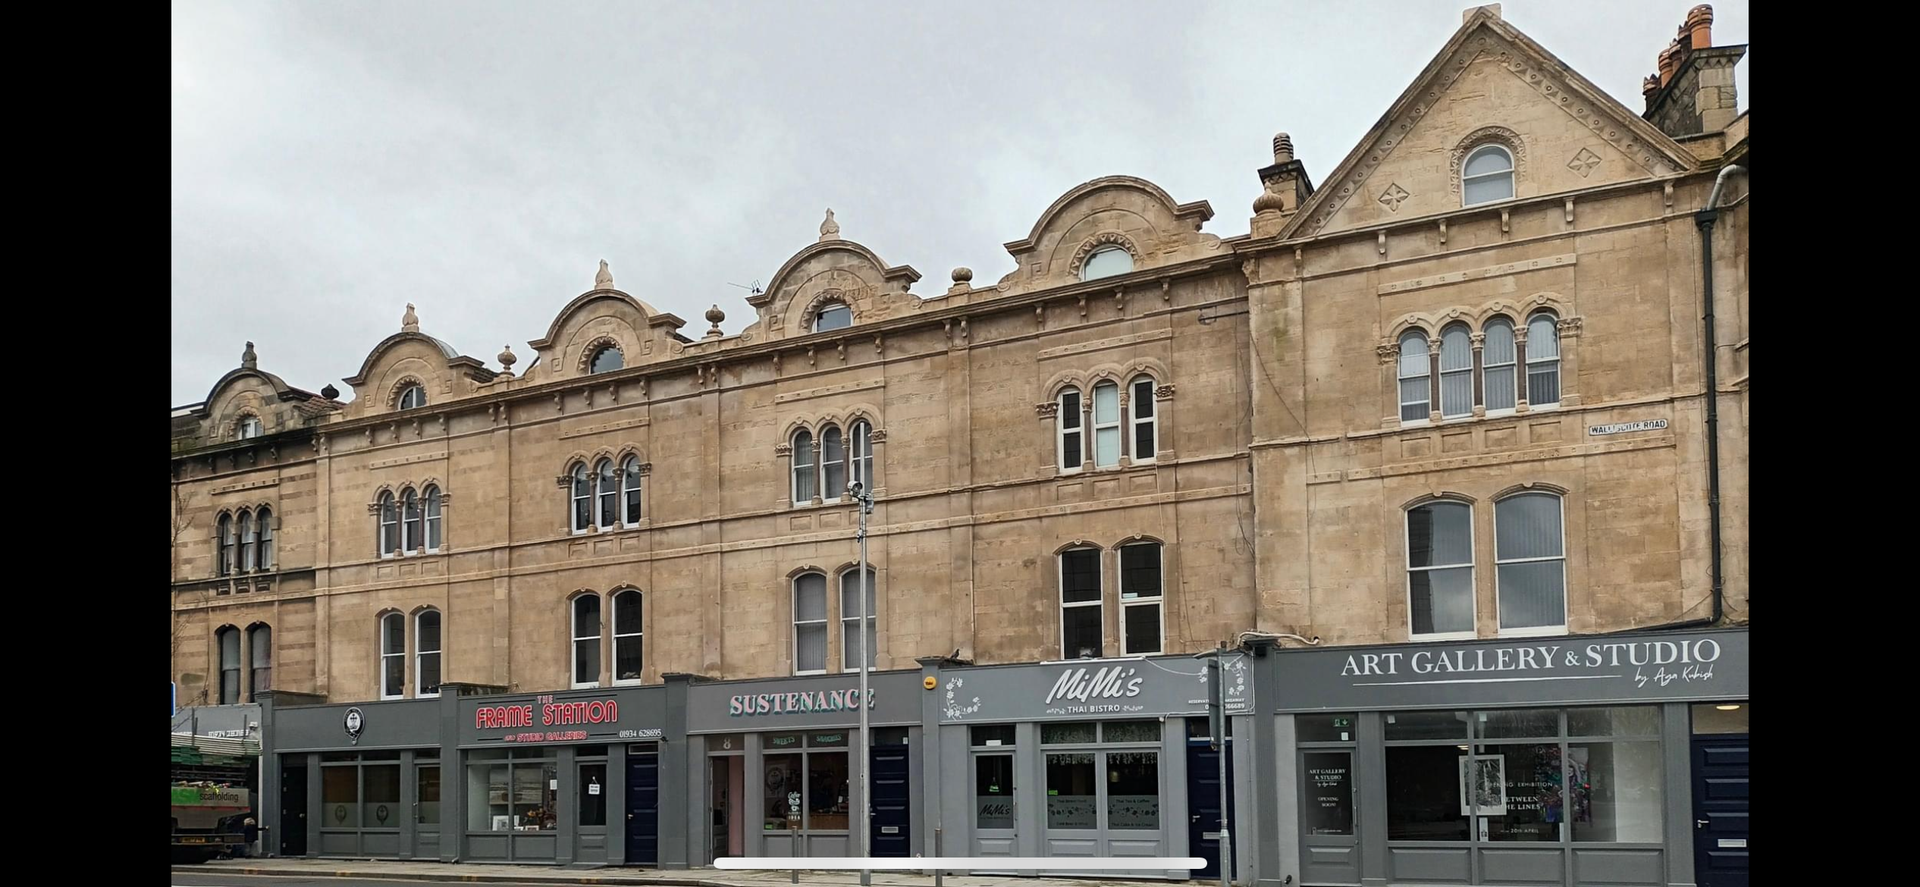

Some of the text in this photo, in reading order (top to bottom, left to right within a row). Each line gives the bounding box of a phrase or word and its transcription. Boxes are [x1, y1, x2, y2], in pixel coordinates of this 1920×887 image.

[1643, 420, 1666, 430] ROAD
[1340, 638, 1721, 676] ART GALLERY & STUDIO
[1045, 666, 1143, 704] MiMi's
[1634, 666, 1650, 688] by
[1653, 666, 1678, 687] Aga
[536, 695, 553, 704] THE
[729, 688, 875, 717] SUSTENANCE
[475, 700, 618, 729] FRAME STATION
[1067, 704, 1120, 714] THAI BISTRO
[516, 733, 545, 743] STUDIO
[545, 730, 588, 742] GALLERIES
[619, 728, 662, 738] 01934 628695
